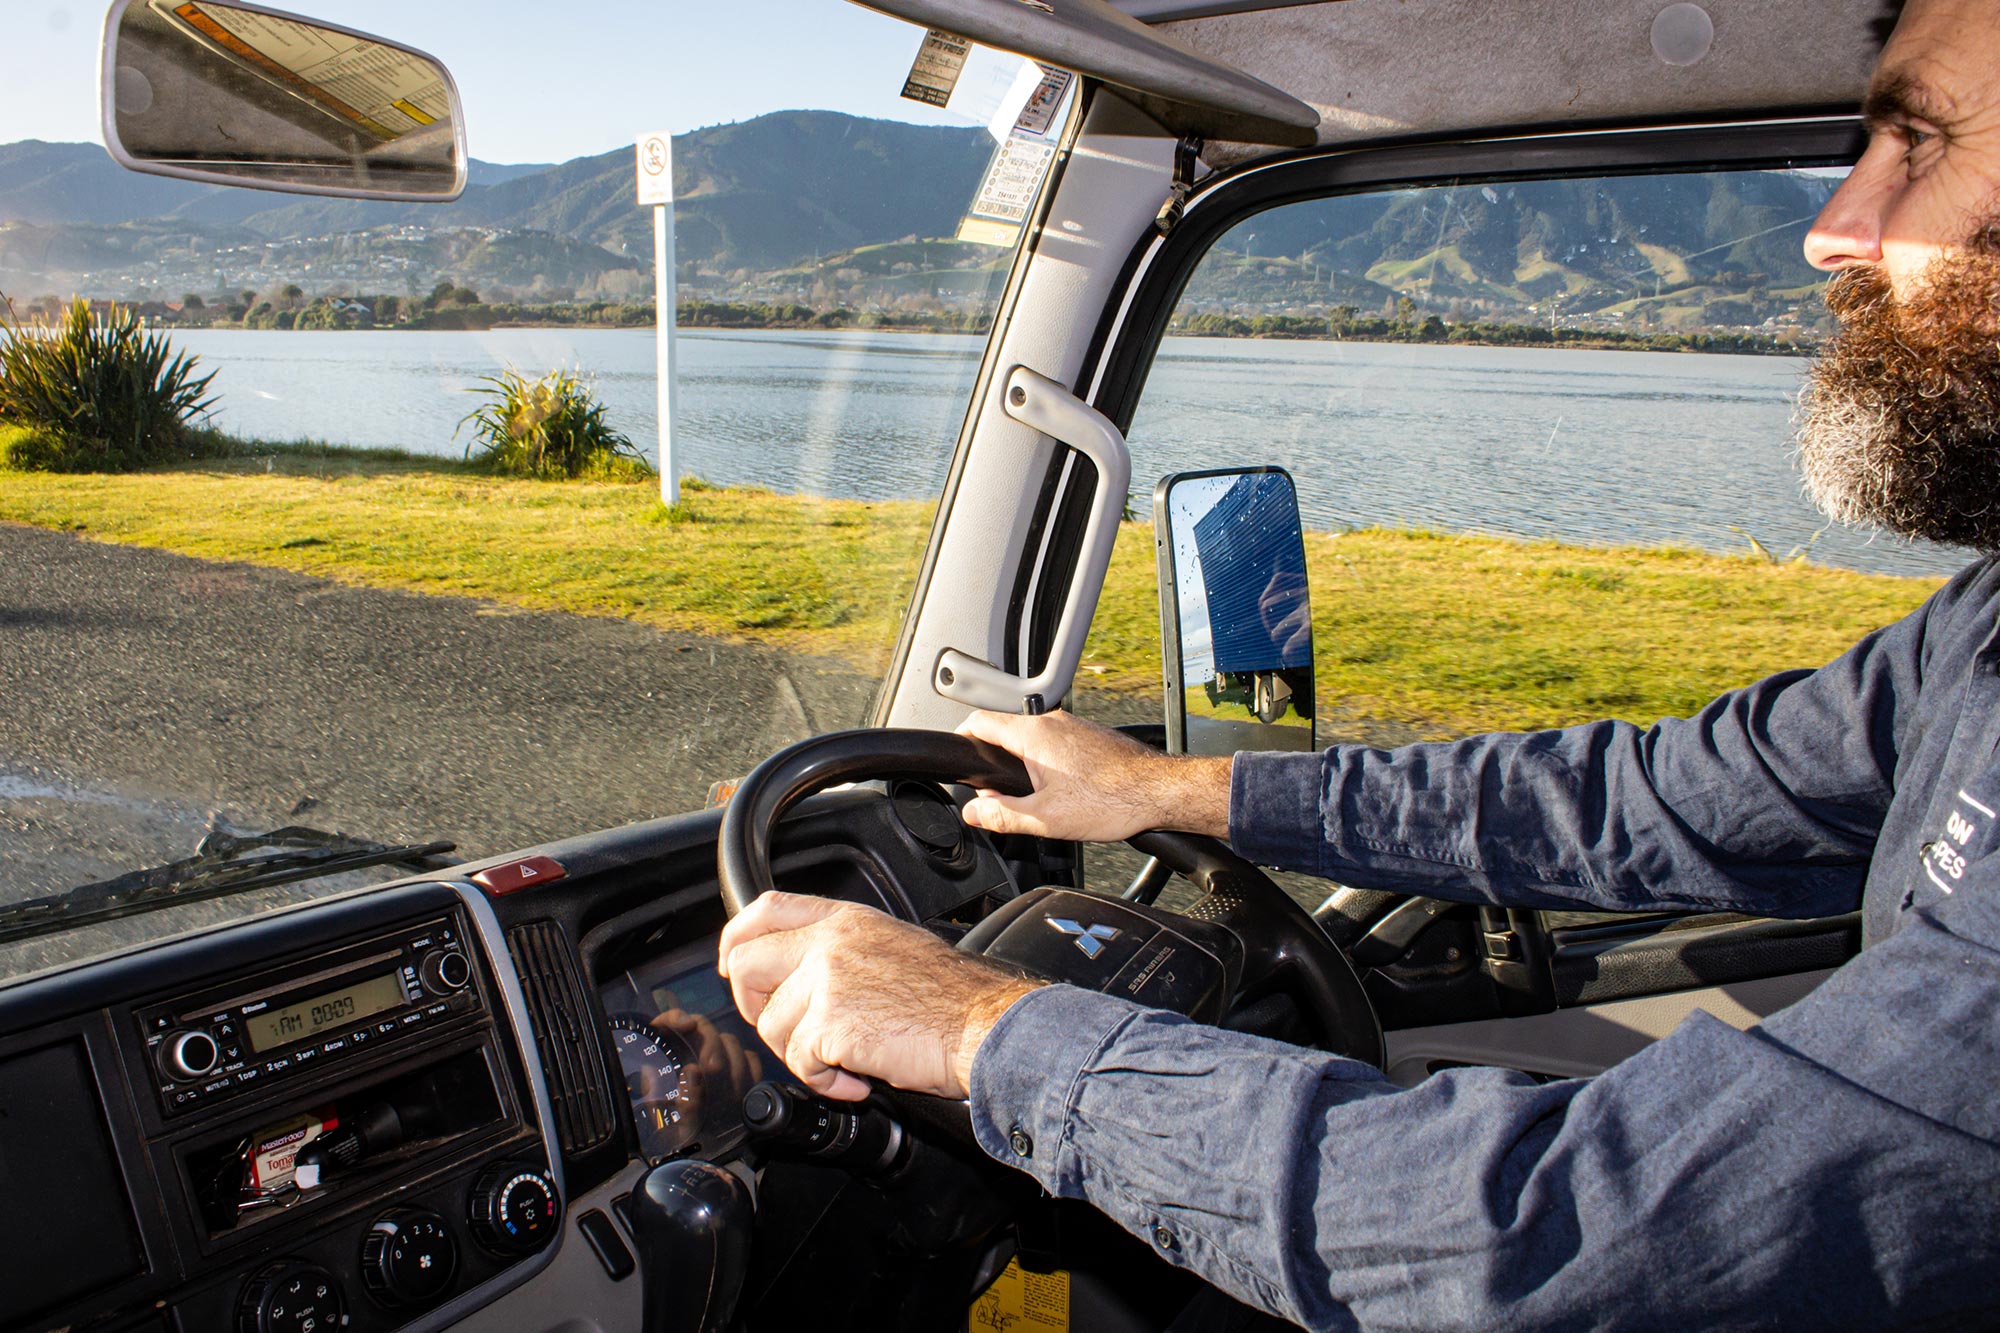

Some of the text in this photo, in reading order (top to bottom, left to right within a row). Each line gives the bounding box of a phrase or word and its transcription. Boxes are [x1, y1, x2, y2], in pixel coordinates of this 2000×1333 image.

[412, 938, 431, 949] MODE
[1127, 946, 1172, 991] SRS AIRBAG
[403, 1013, 421, 1023] MENU
[623, 1033, 637, 1044] 100
[643, 1044, 657, 1056] 120
[226, 1061, 245, 1071] TRACK
[658, 1065, 672, 1077] 140
[162, 1084, 175, 1092] FILE
[665, 1089, 680, 1100] 160
[664, 1117, 670, 1126] F
[519, 1198, 535, 1208] PUSH
[395, 1224, 444, 1260] 0 1 2 3 4
[295, 1306, 315, 1319] PUSH
